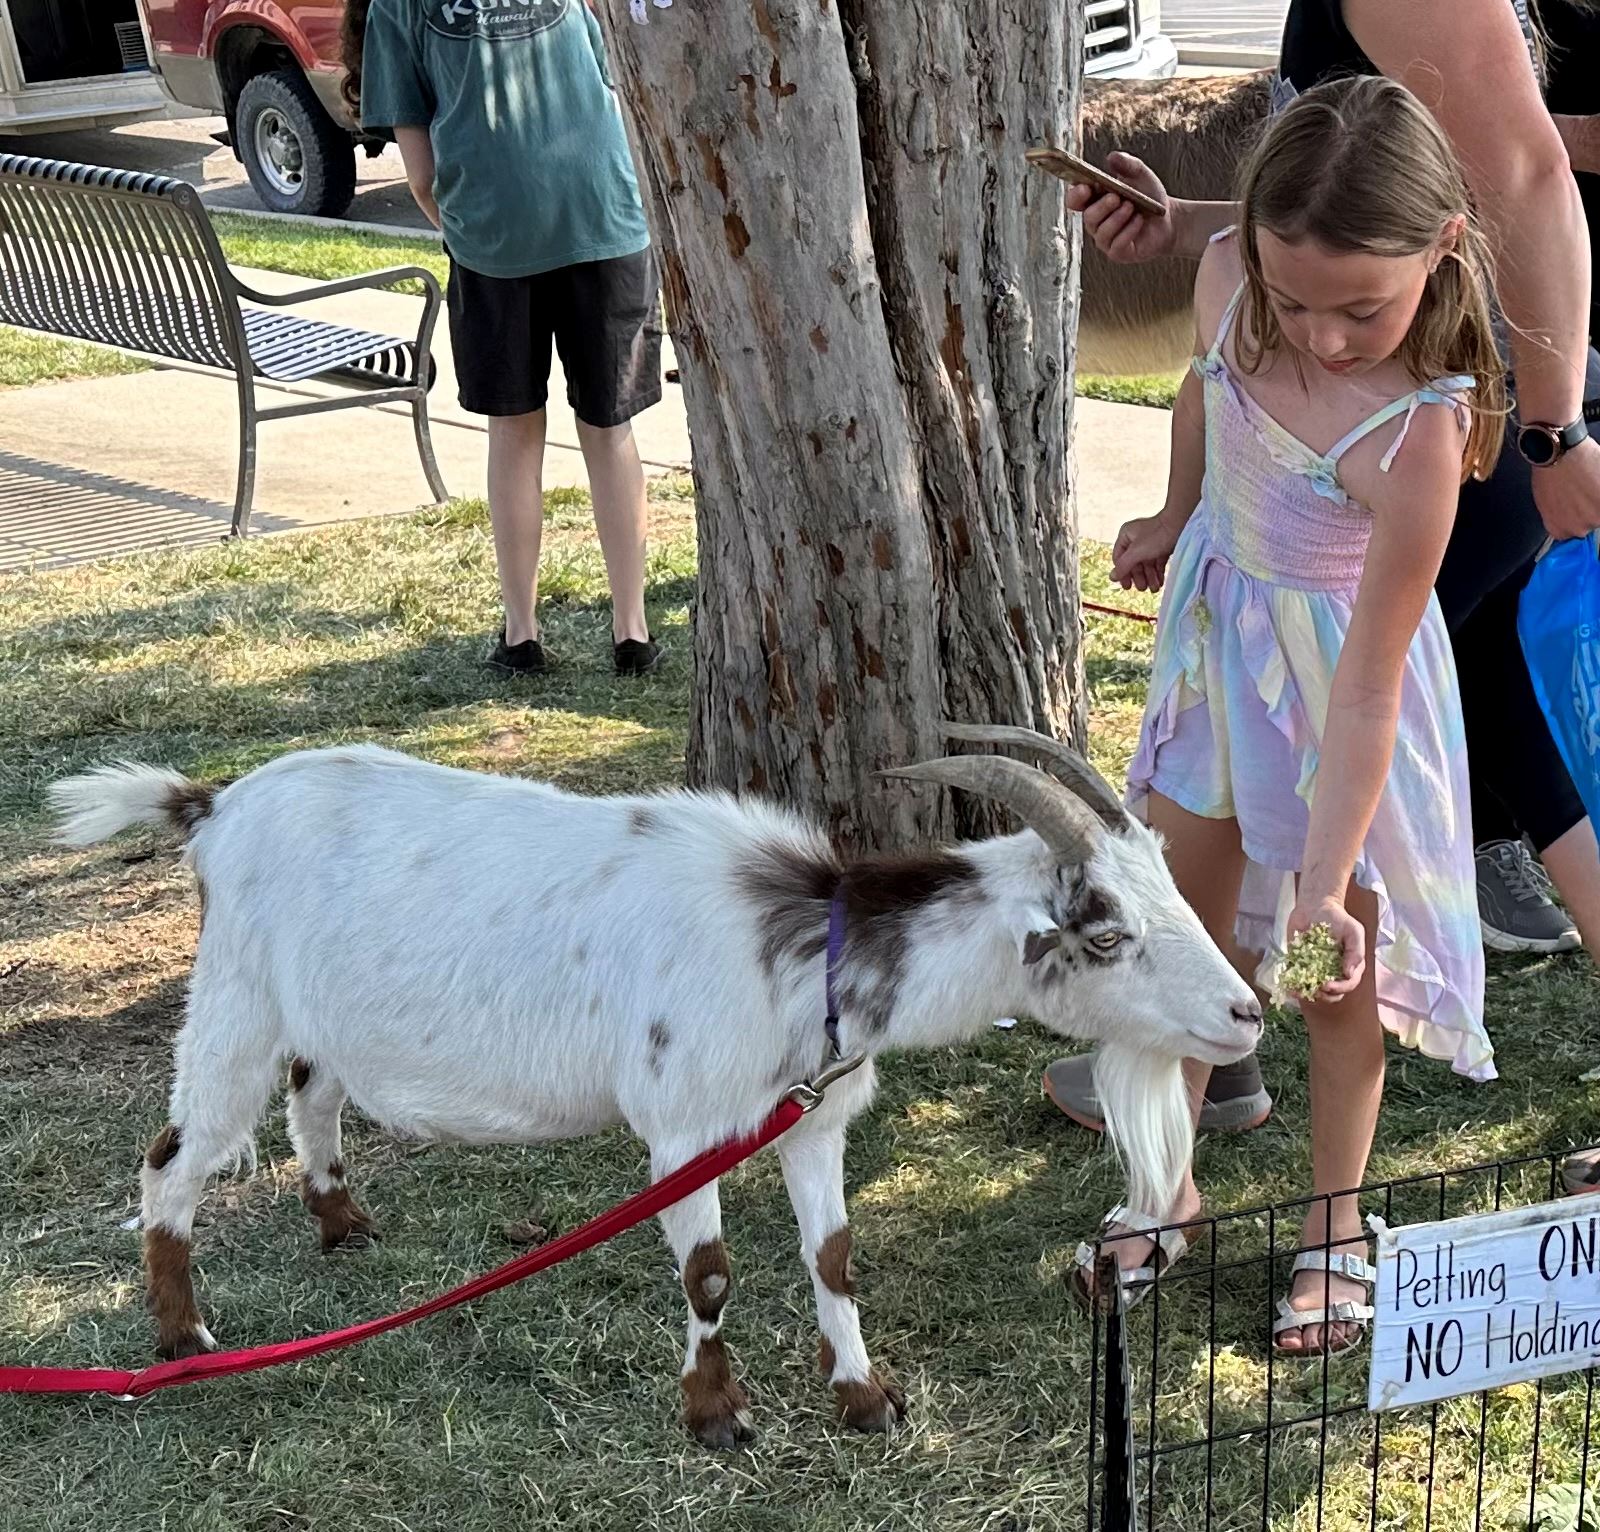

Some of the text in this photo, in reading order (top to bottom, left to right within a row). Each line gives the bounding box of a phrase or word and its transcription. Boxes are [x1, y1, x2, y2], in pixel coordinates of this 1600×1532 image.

[1395, 1217, 1600, 1311] Petting ON
[1405, 1319, 1463, 1382] NO
